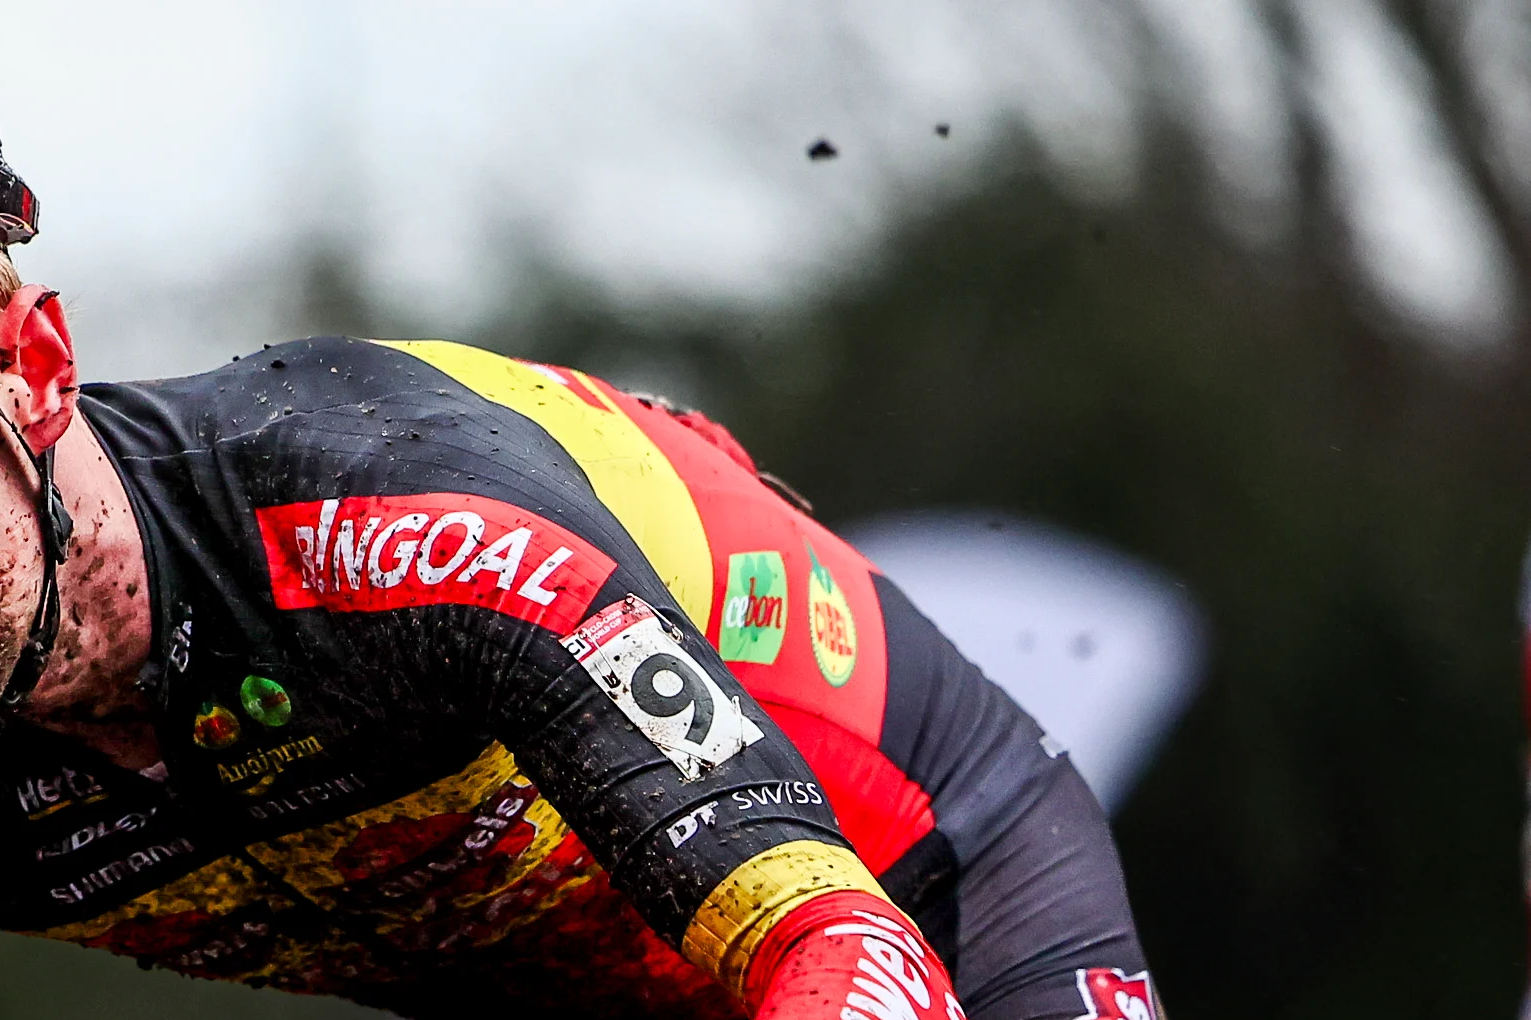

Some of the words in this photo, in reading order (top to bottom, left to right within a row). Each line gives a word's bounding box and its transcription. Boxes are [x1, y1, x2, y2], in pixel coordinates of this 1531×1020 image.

[631, 652, 715, 746] 9
[665, 800, 719, 849] DT
[731, 781, 823, 811] SWISS
